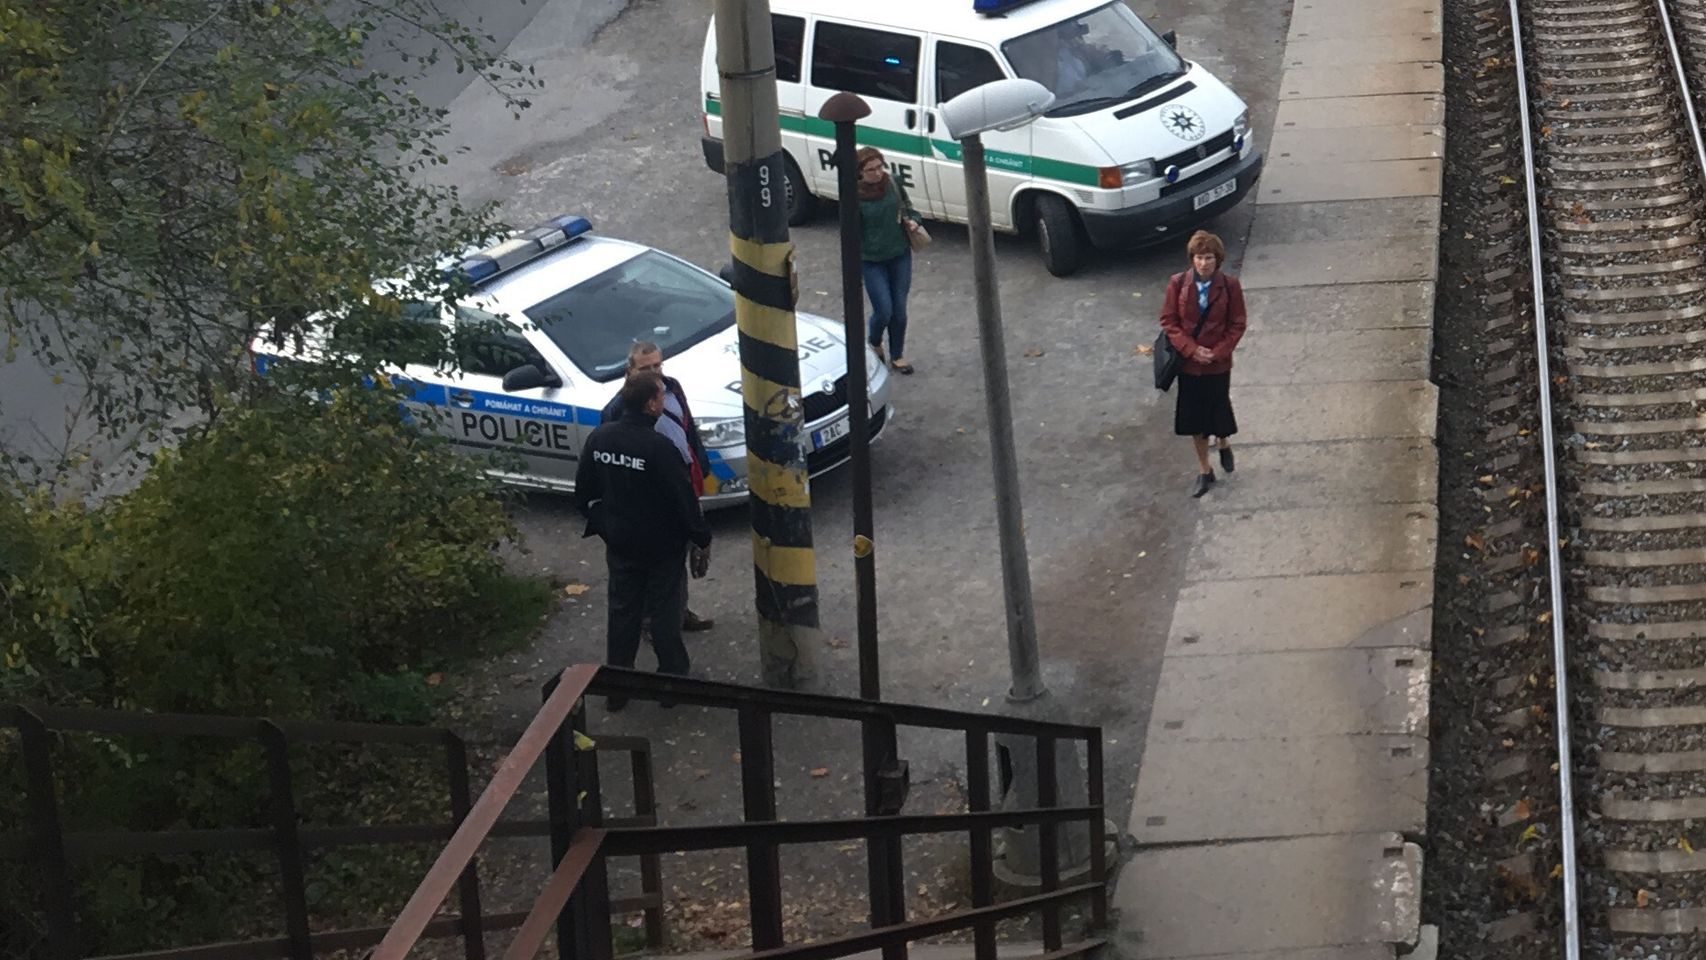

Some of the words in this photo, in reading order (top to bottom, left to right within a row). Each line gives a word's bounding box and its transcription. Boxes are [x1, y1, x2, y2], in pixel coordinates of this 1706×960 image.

[485, 399, 522, 412] POMÁHAT
[524, 403, 530, 413] A
[531, 403, 567, 417] CHRÁNIT
[461, 412, 571, 451] POLICIE
[593, 450, 646, 471] POLICIE
